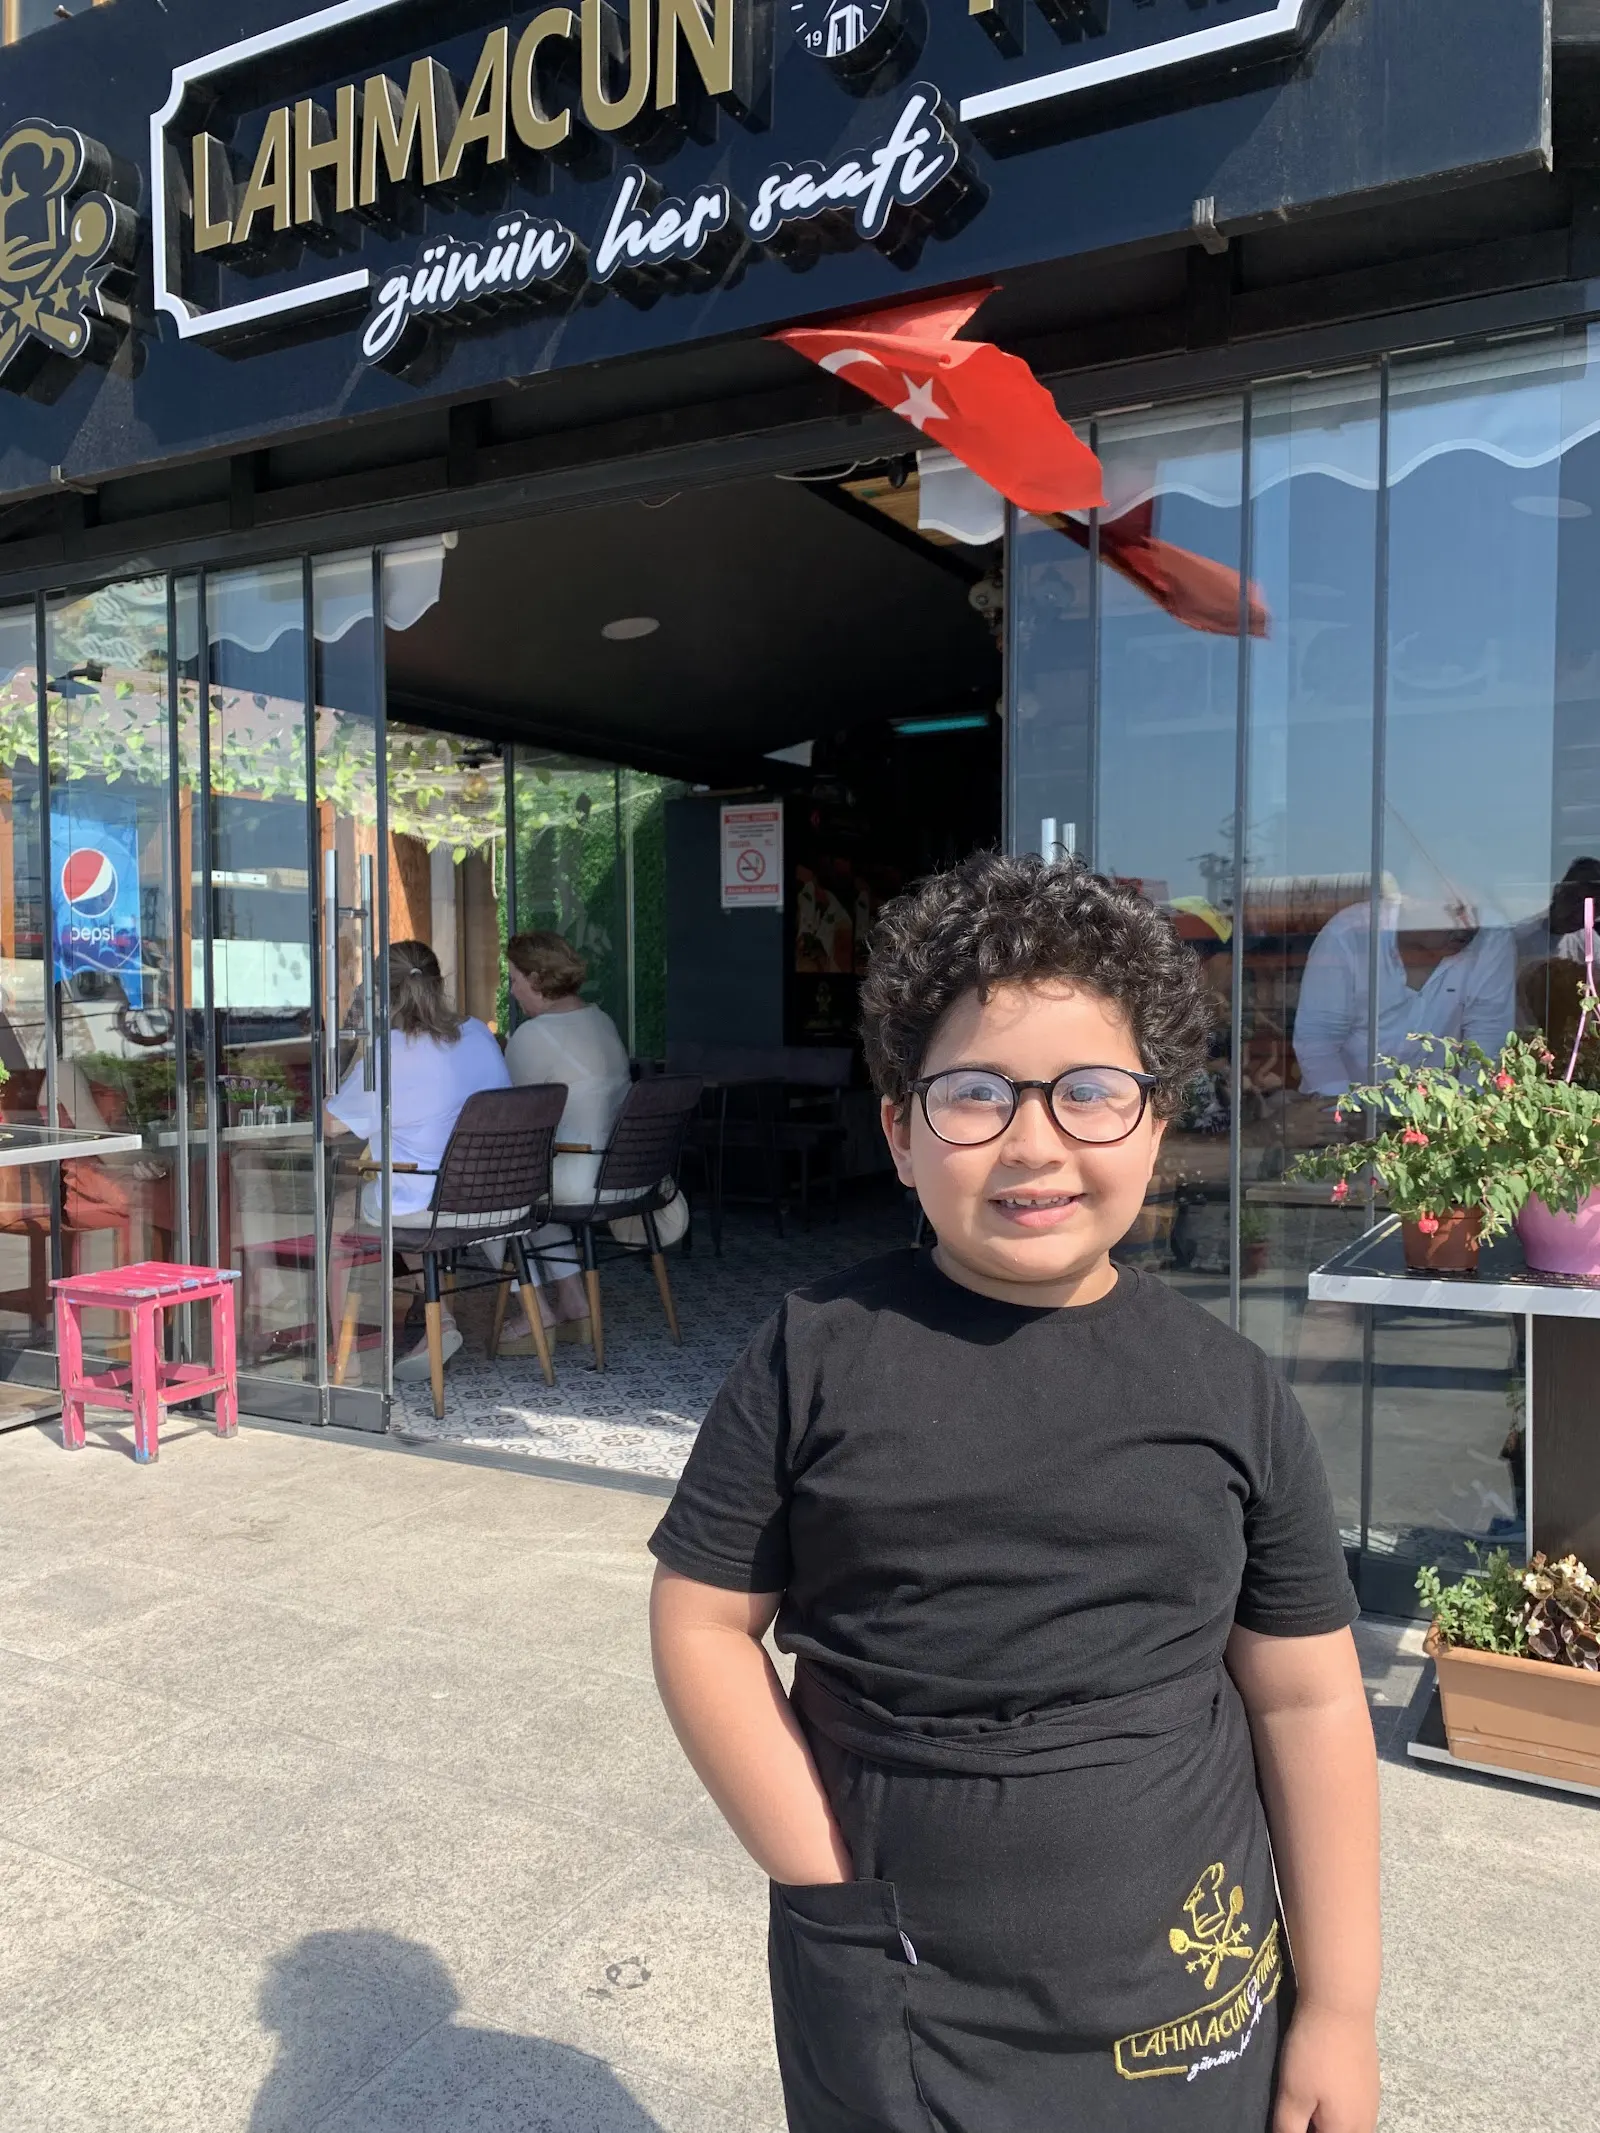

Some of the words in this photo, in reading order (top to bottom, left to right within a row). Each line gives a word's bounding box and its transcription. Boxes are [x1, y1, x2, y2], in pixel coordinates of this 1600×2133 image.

[804, 30, 823, 48] 19
[193, 0, 733, 253] LAHMACUN
[363, 219, 567, 358] günün
[598, 177, 721, 274] her
[749, 95, 944, 229] saati
[70, 924, 115, 946] pepsi
[1131, 1987, 1251, 2058] LAHMACUN
